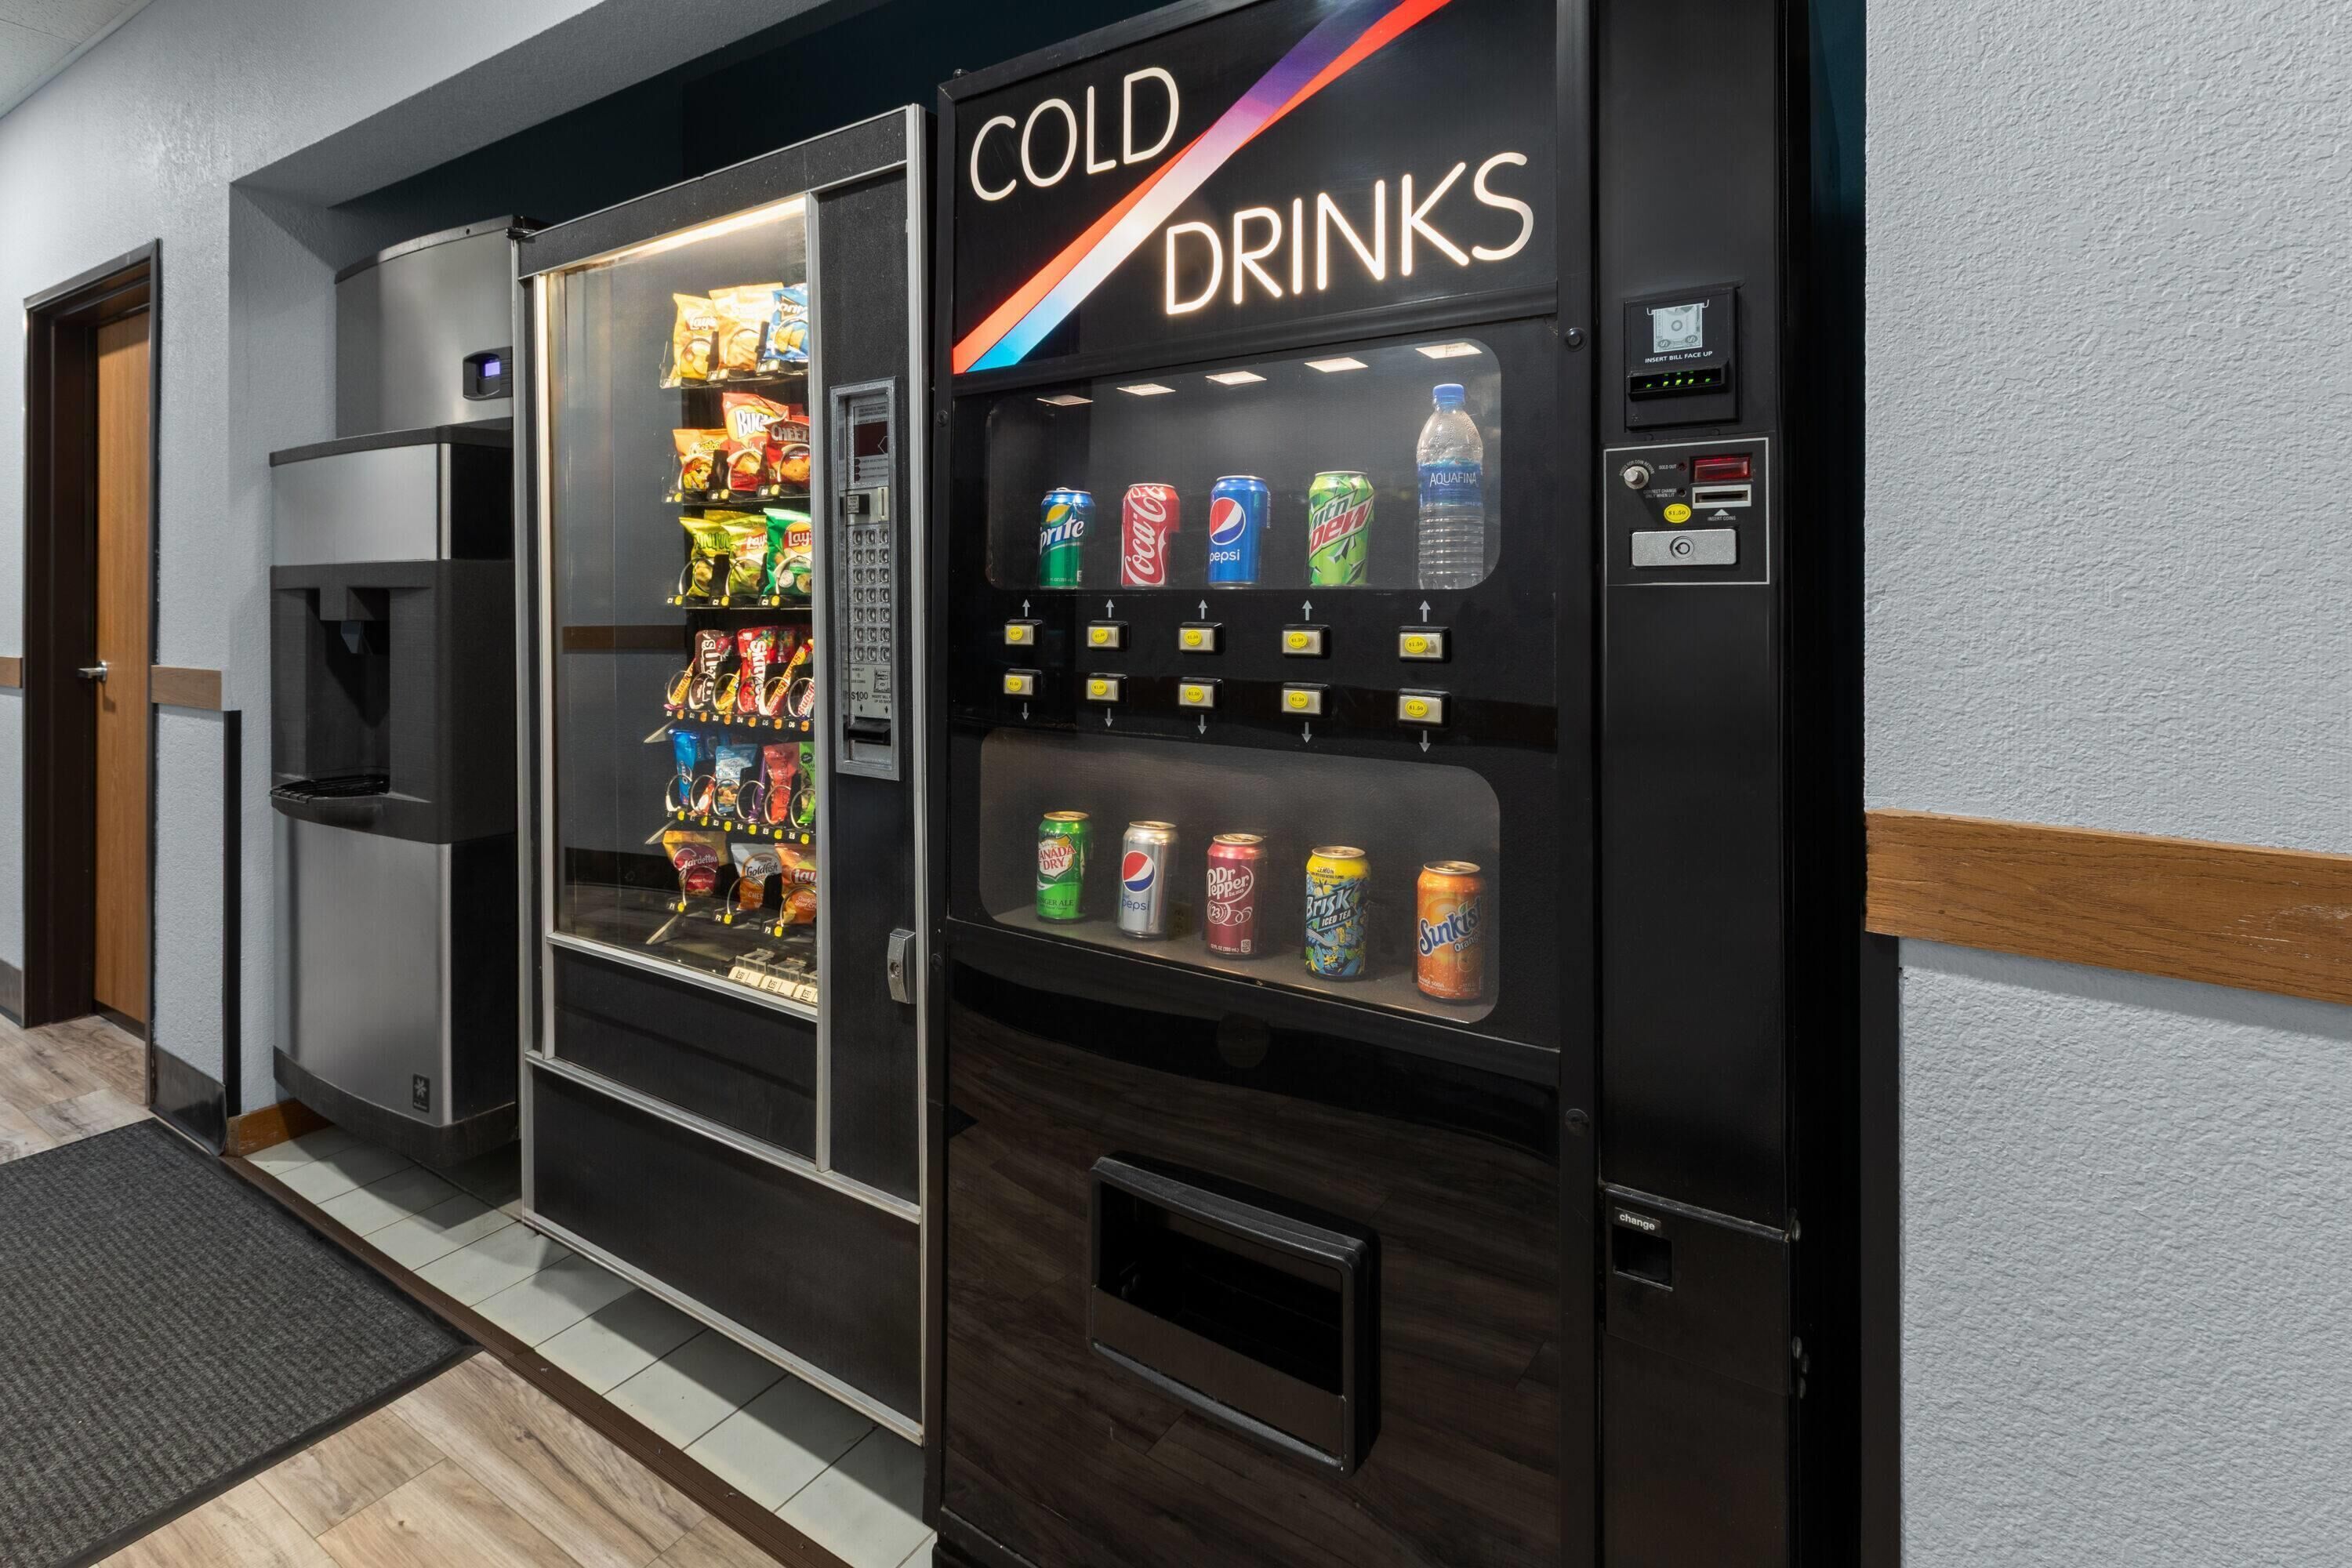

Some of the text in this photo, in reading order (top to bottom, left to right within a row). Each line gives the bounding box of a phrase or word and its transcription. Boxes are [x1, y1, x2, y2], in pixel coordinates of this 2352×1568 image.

[970, 67, 1179, 201] COLD
[1166, 151, 1534, 315] DRINKS
[735, 409, 768, 439] BUG
[1430, 472, 1477, 487] AQUAFINA
[1040, 514, 1084, 555] prite
[1210, 550, 1240, 564] pepsi
[750, 640, 768, 705] Skitte
[851, 691, 868, 702] $1.00
[1040, 844, 1077, 860] ANADA
[746, 862, 778, 877] Goldfish
[1044, 858, 1065, 870] DRY
[795, 869, 816, 885] Lay
[1216, 867, 1236, 884] Dr
[1207, 869, 1249, 900] Pepper
[748, 891, 764, 900] CHED
[1040, 897, 1058, 906] NGER
[1122, 899, 1149, 911] pepsi
[1211, 906, 1221, 919] 23
[1322, 909, 1352, 927] ICED TEA
[1454, 934, 1479, 952] orang
[1619, 1213, 1655, 1231] change
